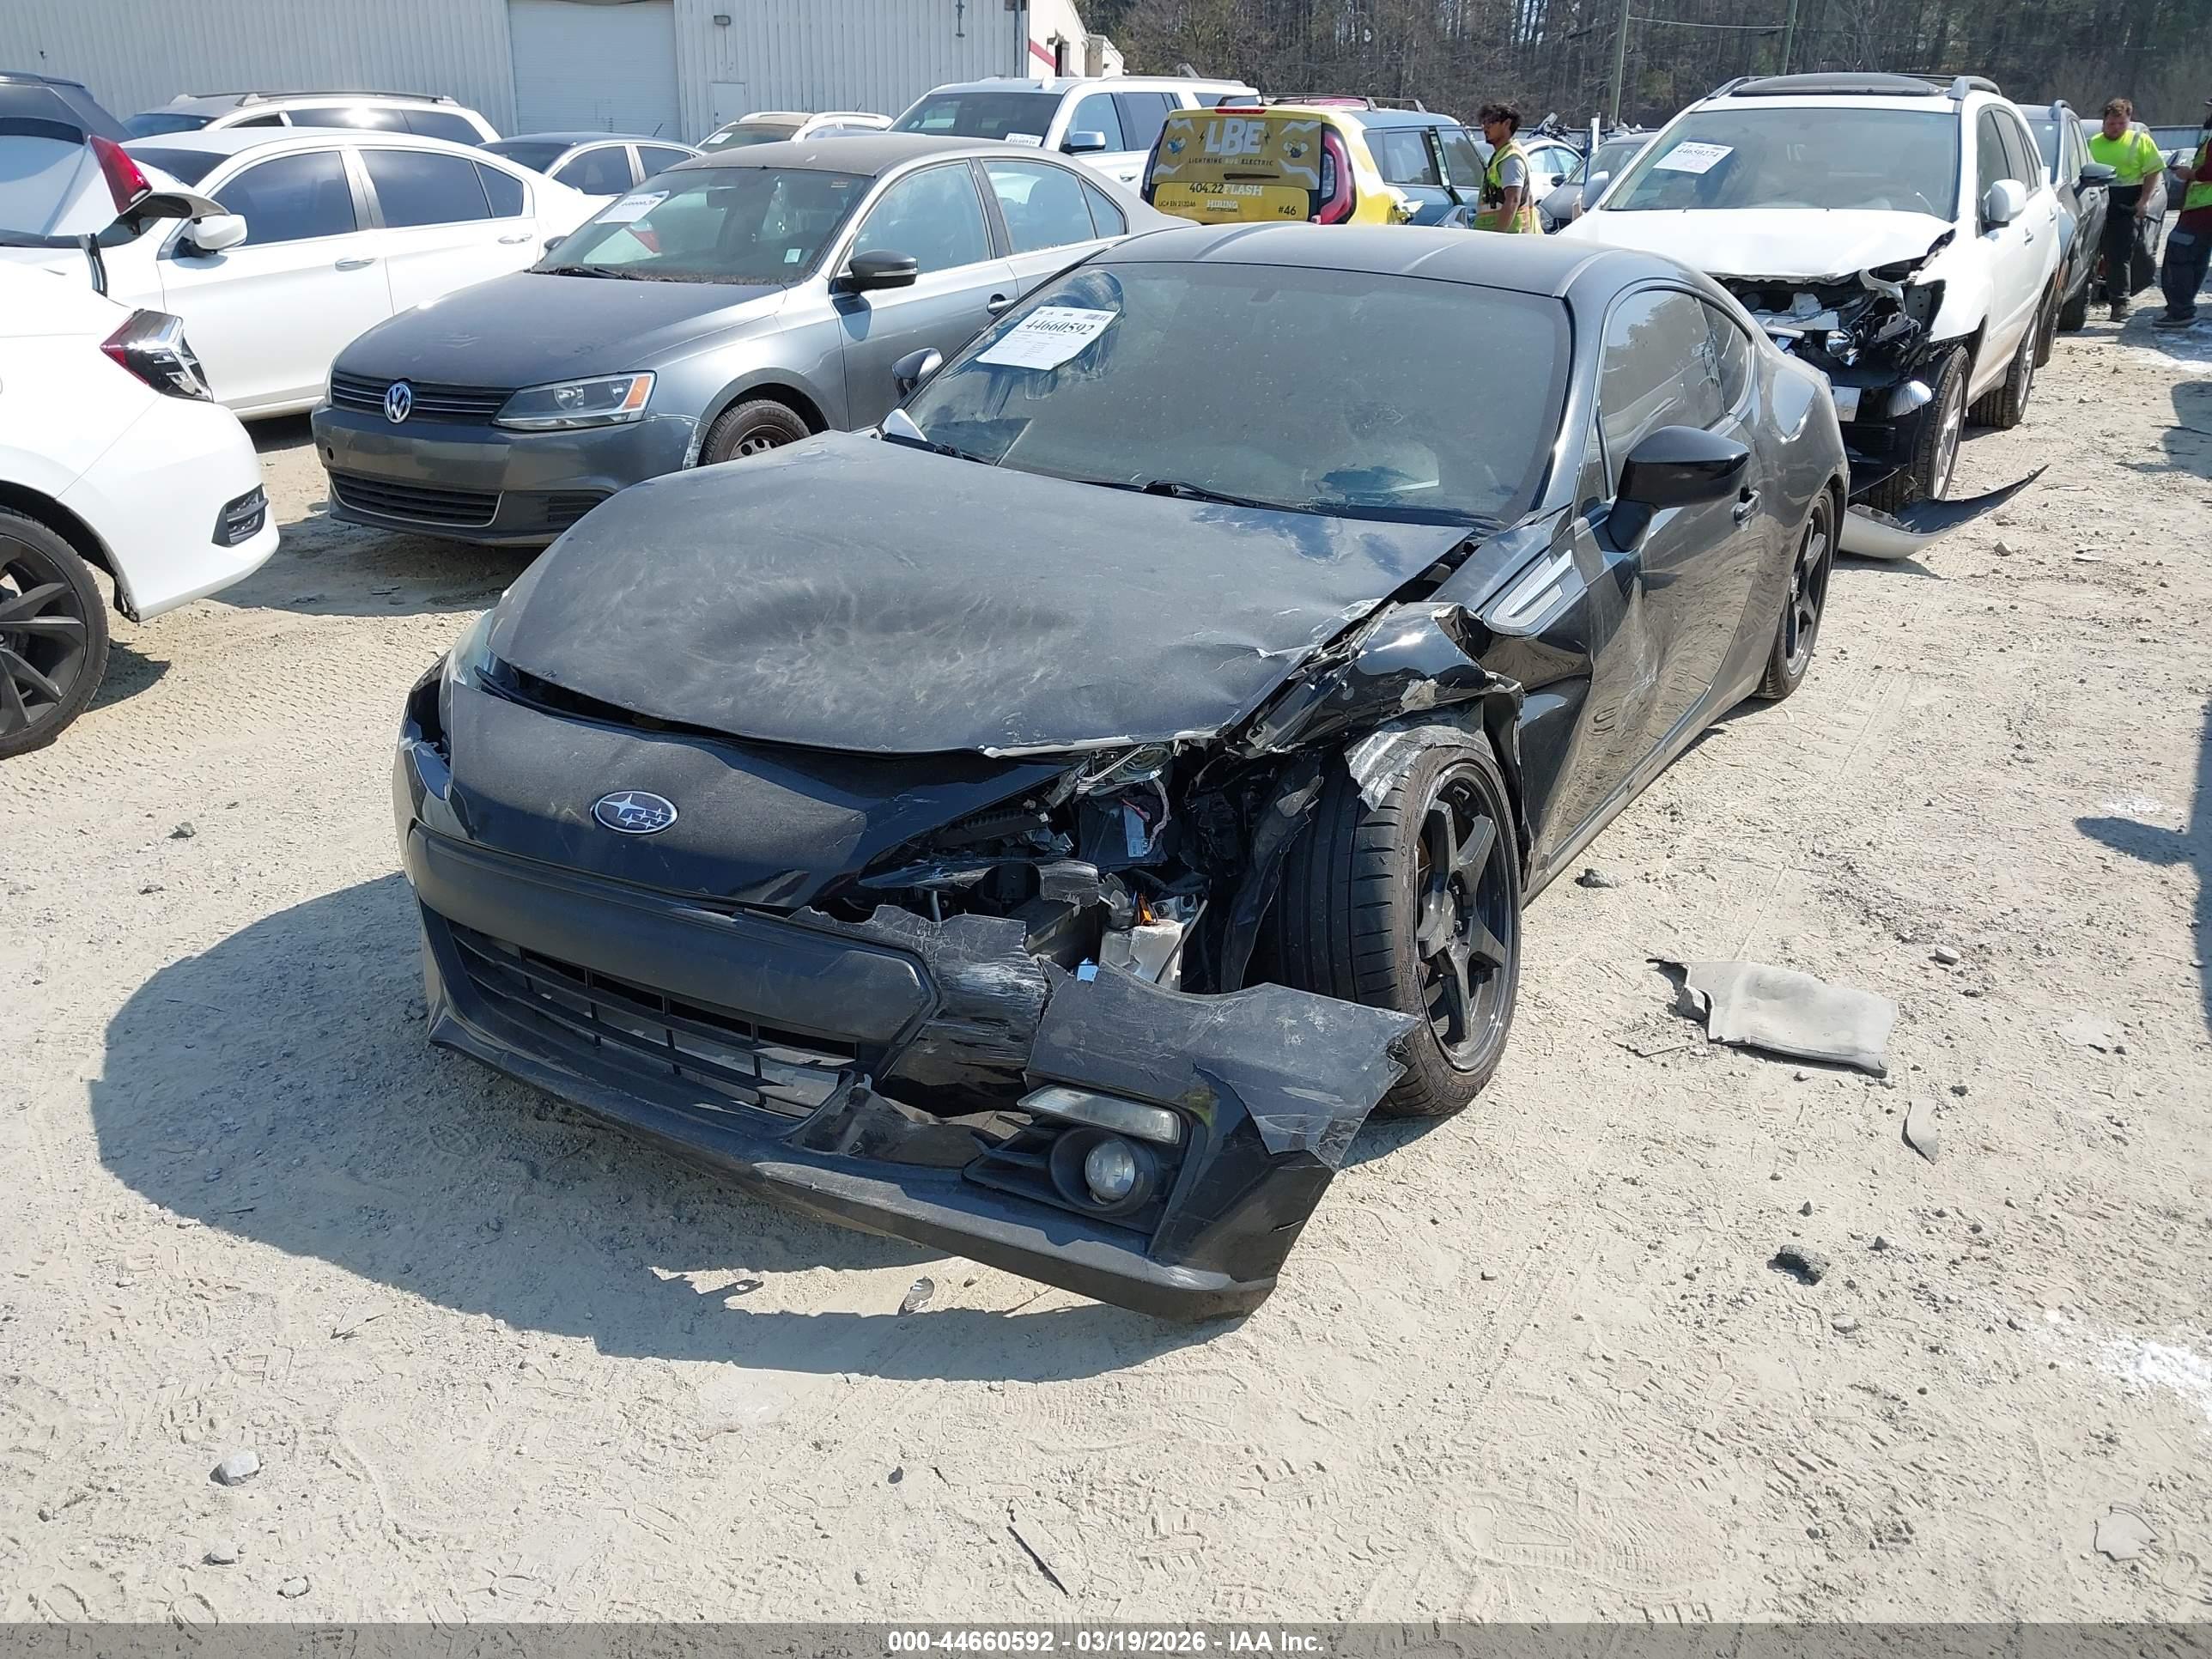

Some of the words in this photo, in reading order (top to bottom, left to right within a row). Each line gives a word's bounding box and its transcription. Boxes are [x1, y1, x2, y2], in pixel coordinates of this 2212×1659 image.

[1204, 118, 1266, 156] LBE
[1241, 158, 1273, 167] ELECTRIC
[1206, 199, 1238, 209] HIRING
[1278, 205, 1297, 216] #46
[1024, 319, 1096, 336] 44660592
